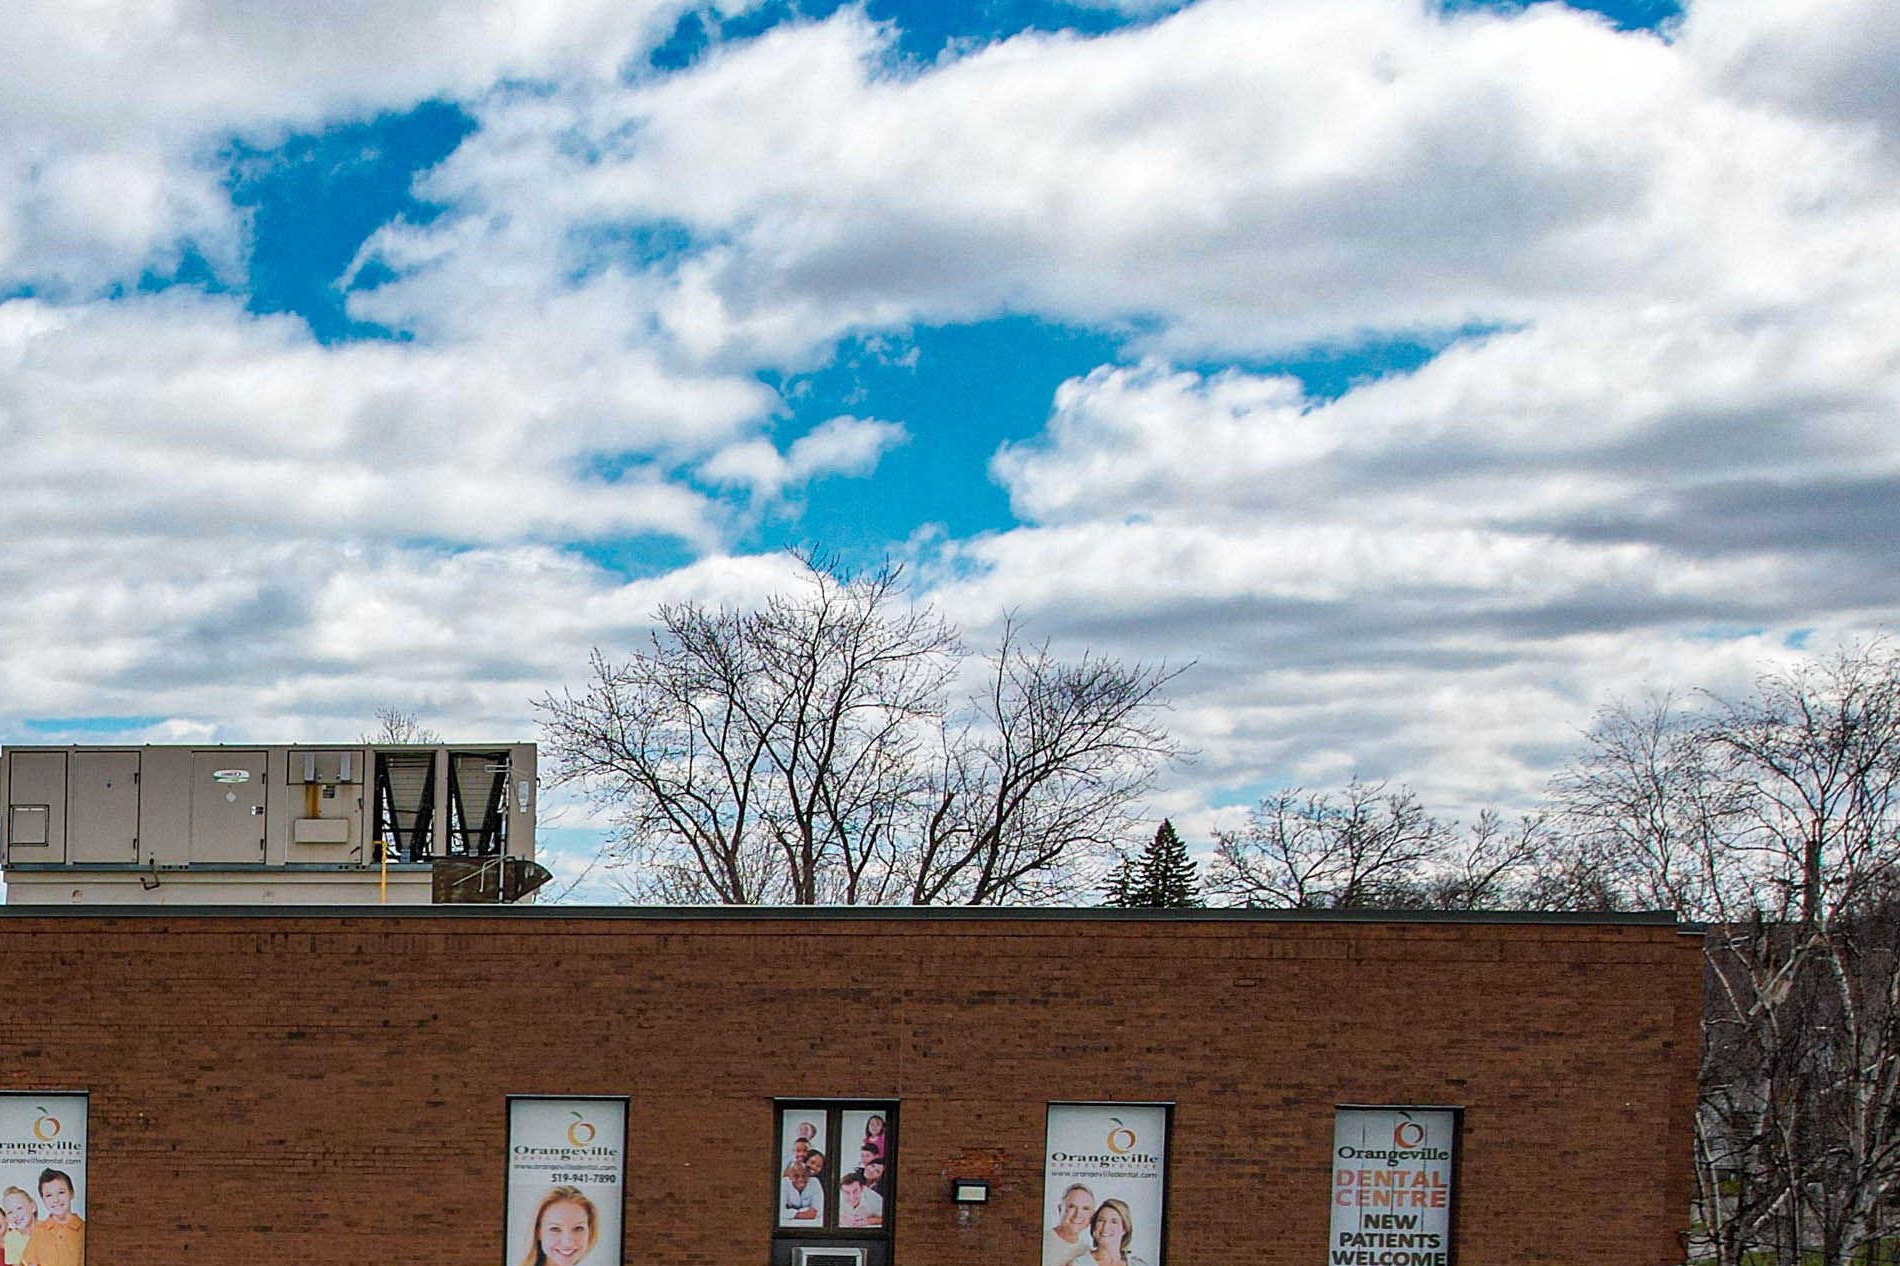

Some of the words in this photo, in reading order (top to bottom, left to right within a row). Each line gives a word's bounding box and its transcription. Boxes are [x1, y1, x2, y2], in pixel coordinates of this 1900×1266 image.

[514, 1145, 618, 1161] Orangeville
[1051, 1152, 1159, 1169] Orangeville
[1338, 1146, 1450, 1167] Orangeville
[551, 1173, 617, 1184] 519-941-7890
[1051, 1170, 1158, 1179] www.orangevilledental.com
[1336, 1169, 1448, 1188] DENTAL
[1335, 1189, 1447, 1208] CENTRE
[1364, 1214, 1418, 1230] NEW
[1339, 1232, 1441, 1249] PATIENTS
